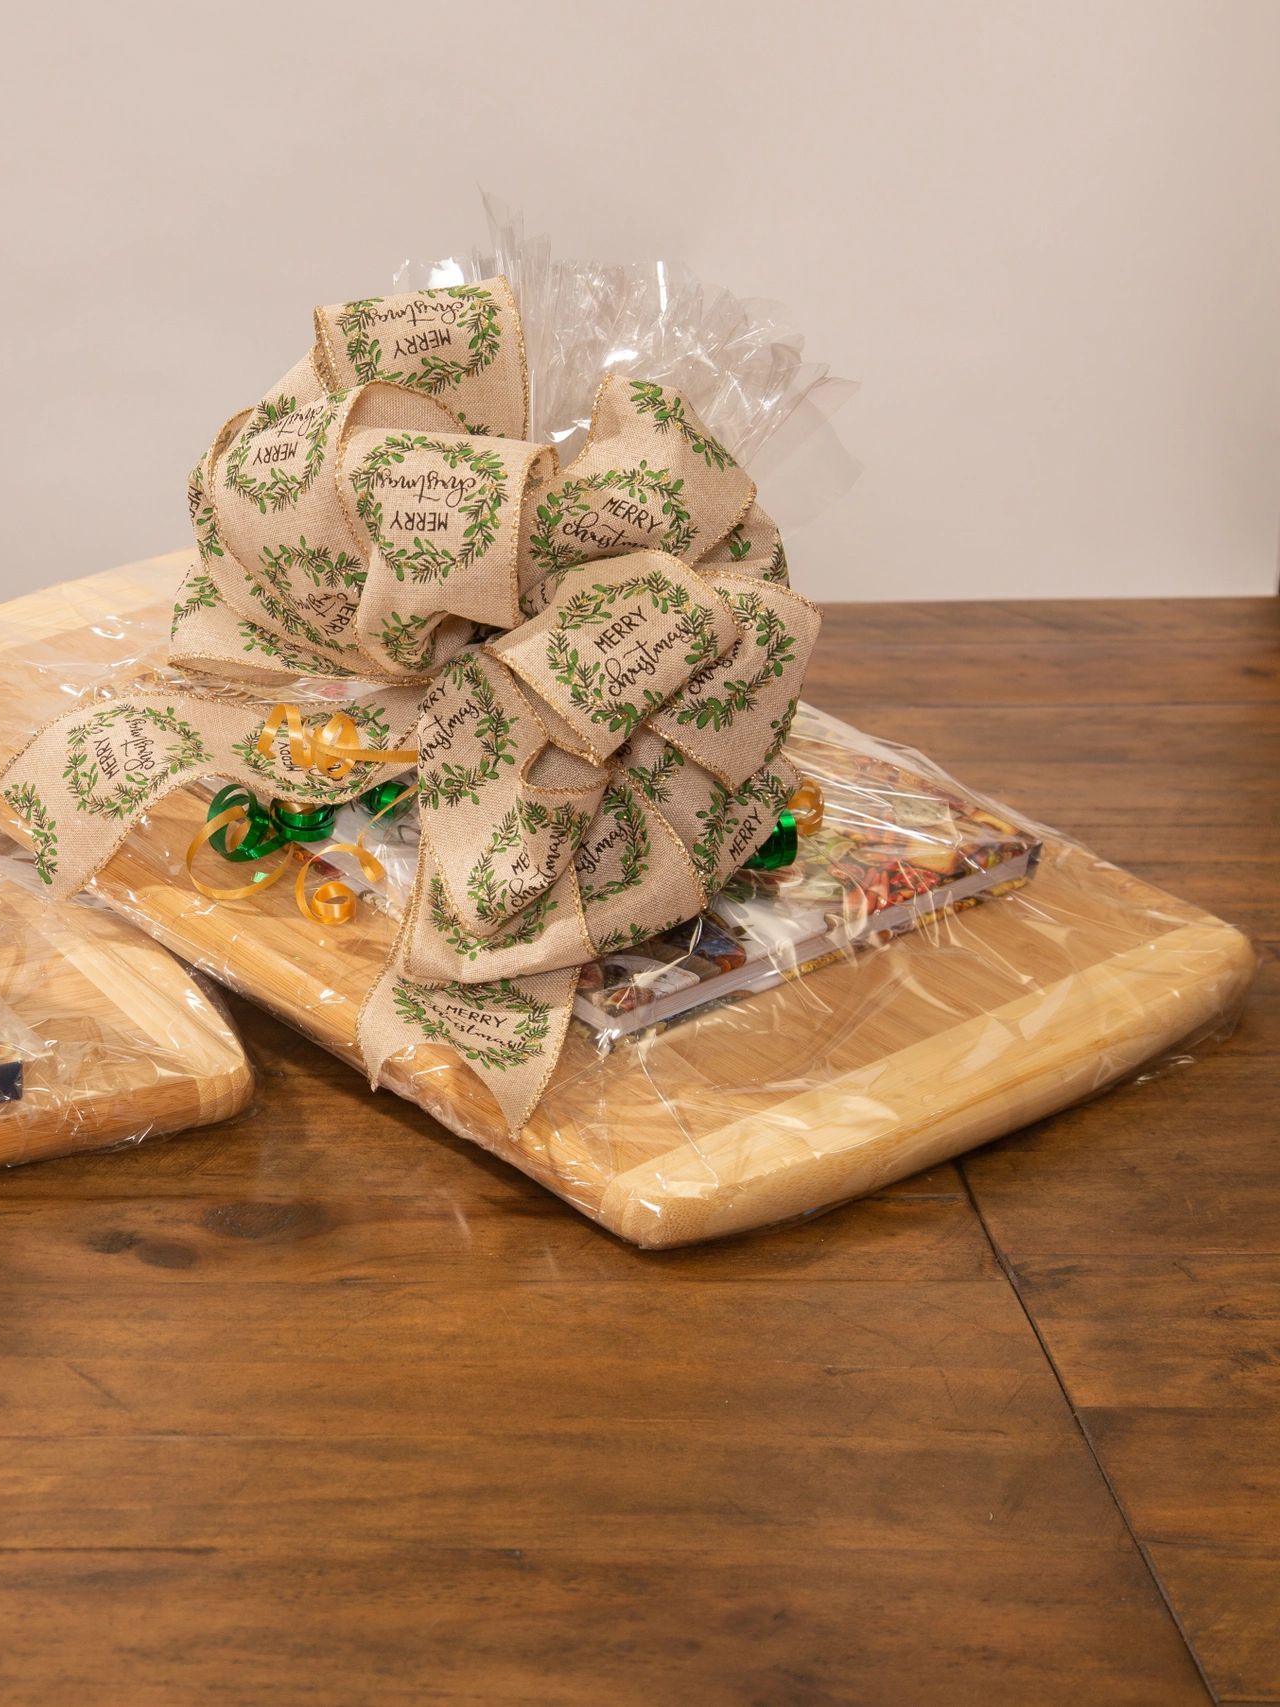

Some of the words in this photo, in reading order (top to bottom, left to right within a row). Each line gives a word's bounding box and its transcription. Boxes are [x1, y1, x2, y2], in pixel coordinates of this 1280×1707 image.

[393, 328, 452, 360] MERRY
[252, 442, 299, 466] MERRY
[389, 510, 449, 532] MERRY
[601, 497, 663, 534] MERRY
[593, 606, 648, 655] MERRY
[418, 680, 446, 714] RRY
[93, 736, 120, 780] MERRY
[728, 806, 763, 862] MERRY
[446, 1004, 508, 1029] MERRY
